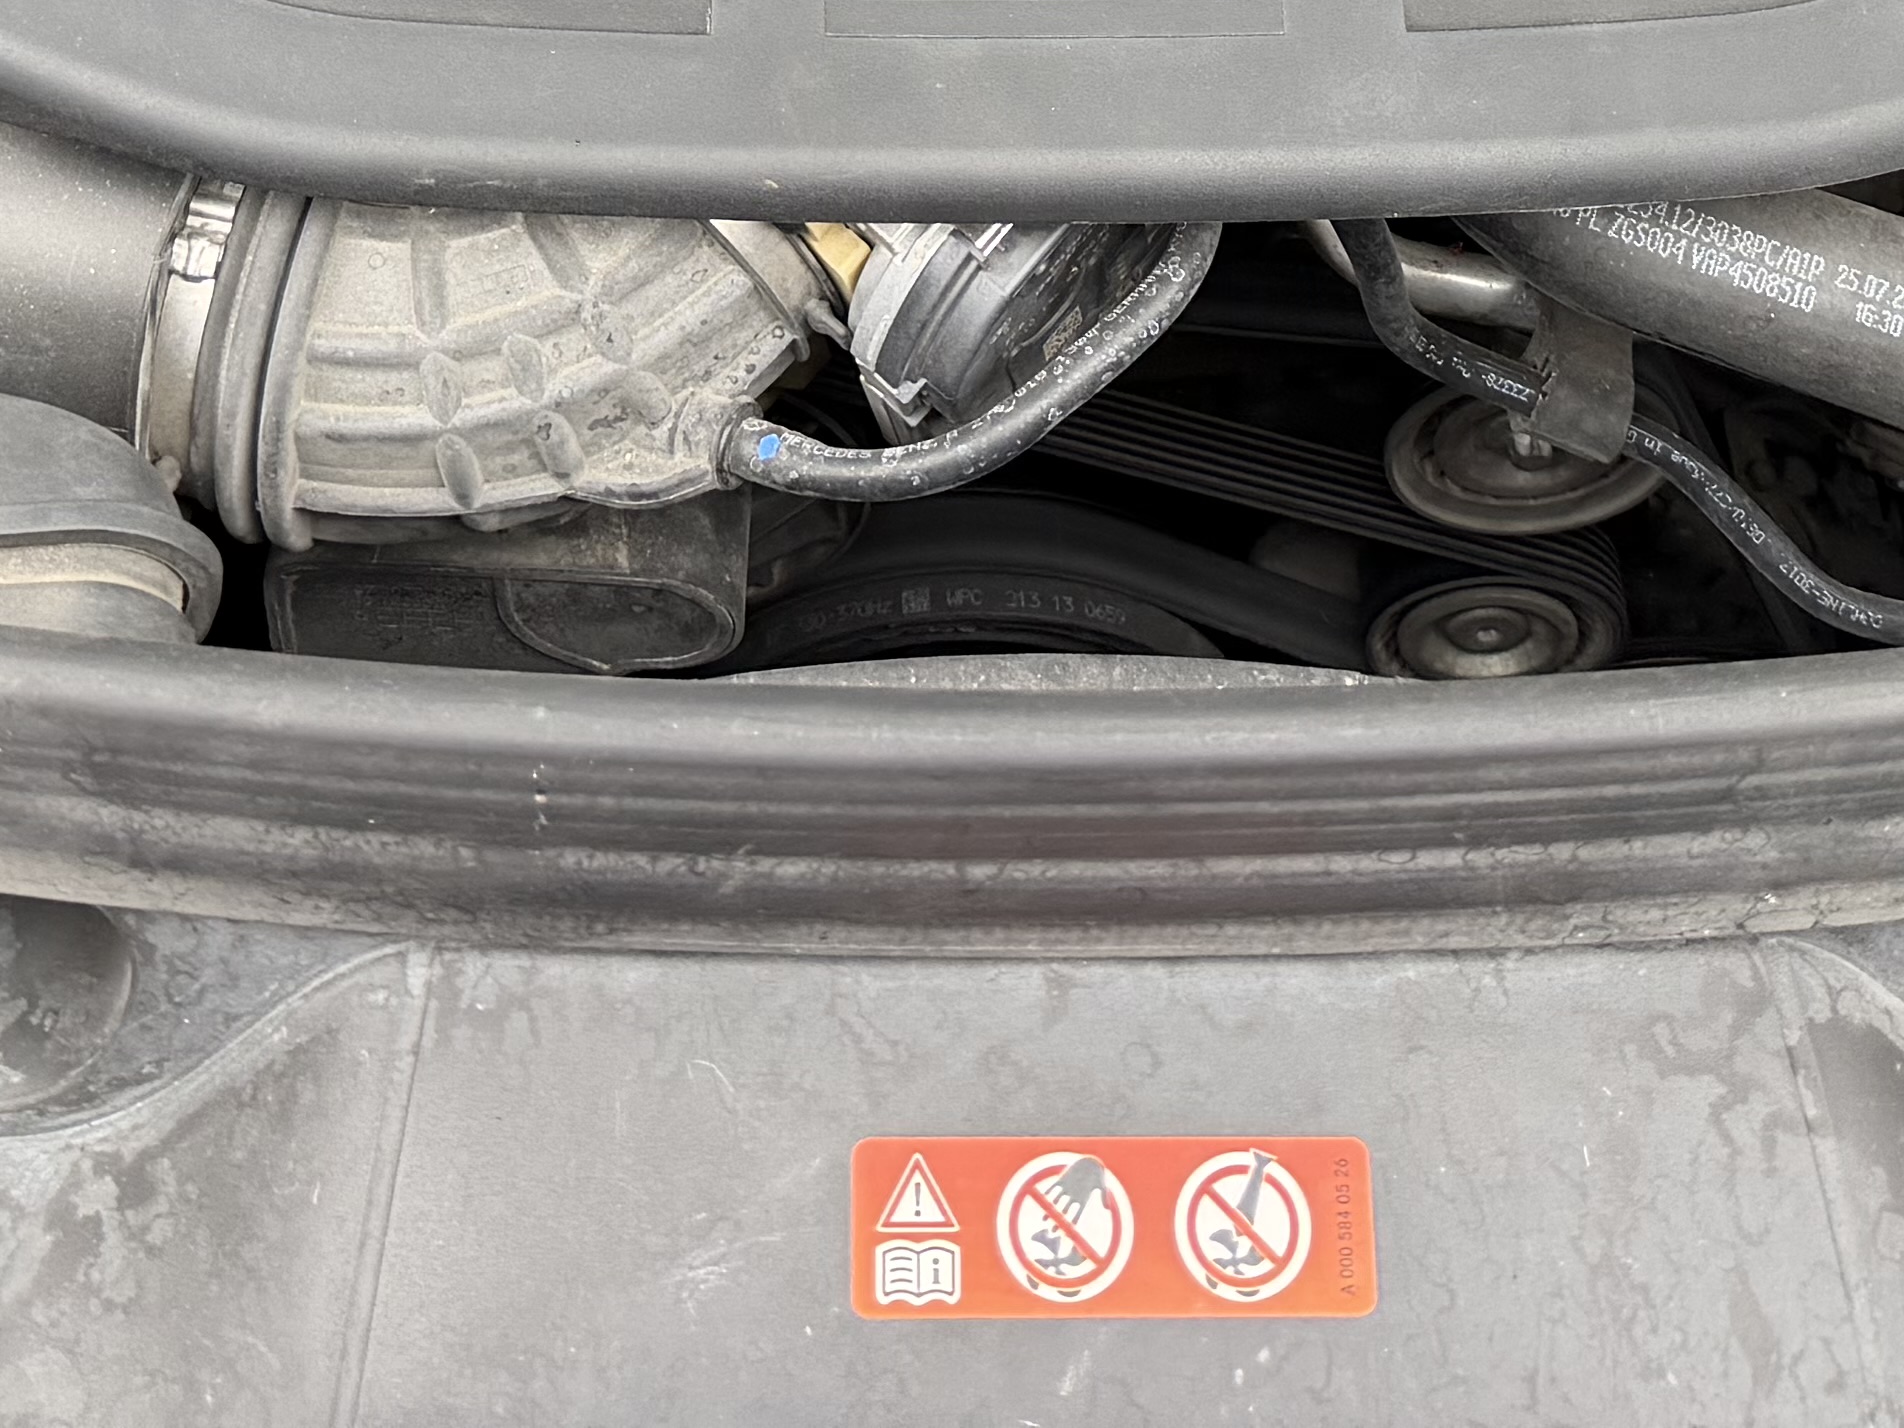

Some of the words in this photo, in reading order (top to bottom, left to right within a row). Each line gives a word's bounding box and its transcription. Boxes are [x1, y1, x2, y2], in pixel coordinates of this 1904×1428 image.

[1607, 210, 1688, 265] ZGS004
[1691, 242, 1817, 313] VAP4508510
[1855, 301, 1904, 338] 16:30
[779, 431, 872, 459] MERCEDES
[1051, 594, 1075, 614] 13
[1333, 1157, 1349, 1177] 26
[1335, 1182, 1351, 1205] 05
[1336, 1210, 1353, 1244] 584
[1338, 1247, 1354, 1279] 000
[1341, 1282, 1356, 1296] A
